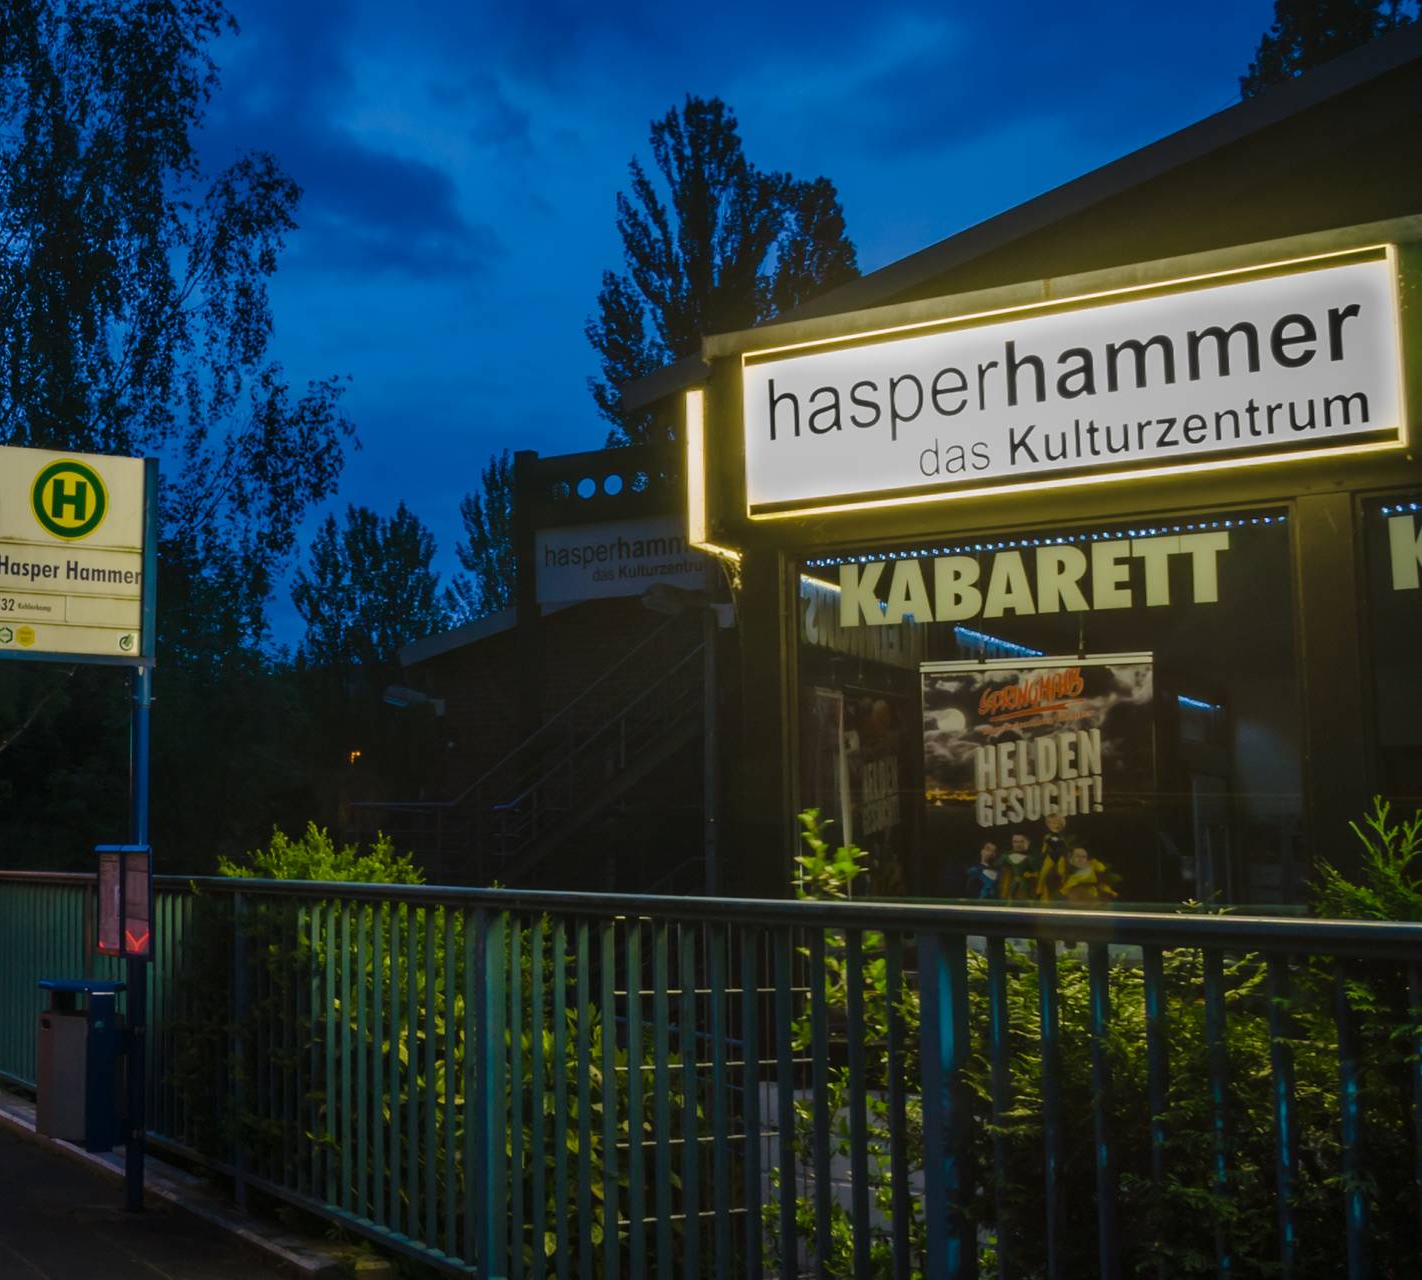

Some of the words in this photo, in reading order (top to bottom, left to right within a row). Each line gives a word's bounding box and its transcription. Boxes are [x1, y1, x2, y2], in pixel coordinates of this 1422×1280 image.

[768, 303, 1361, 441] hasperhammer
[919, 437, 991, 477] das
[1010, 391, 1370, 466] Kulturzentrum
[51, 478, 87, 521] H
[66, 560, 141, 585] Hammer
[545, 535, 687, 569] hasperhamm
[592, 568, 614, 583] das
[618, 557, 706, 579] Kulturzentru
[840, 531, 1230, 627] KABARETT
[974, 728, 1103, 791] HELDEN
[975, 776, 1104, 828] GESUCHT!
